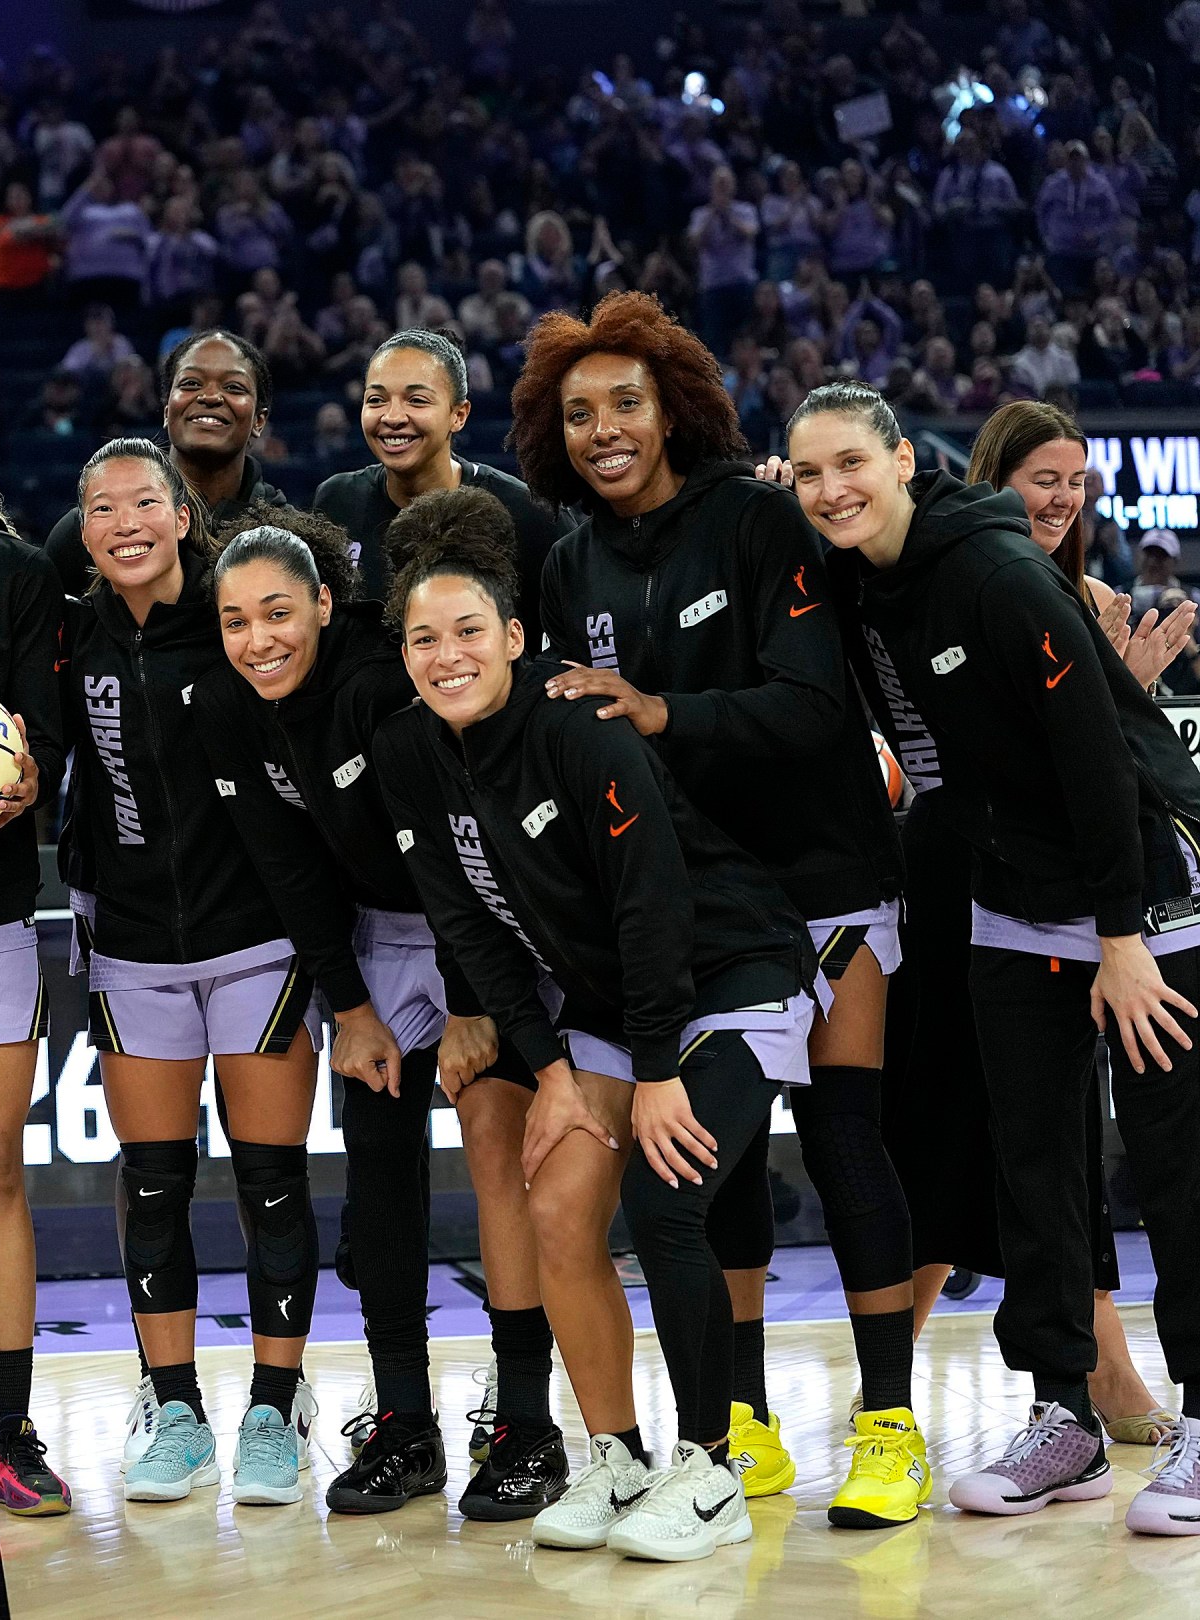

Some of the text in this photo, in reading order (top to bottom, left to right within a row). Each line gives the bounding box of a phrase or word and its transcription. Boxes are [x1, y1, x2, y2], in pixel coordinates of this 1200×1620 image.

[682, 593, 724, 625] IREN
[934, 650, 961, 671] IRN
[84, 675, 146, 845] VALKYRIES
[861, 623, 944, 794] VALKYRIES
[447, 812, 553, 973] LKYRIES
